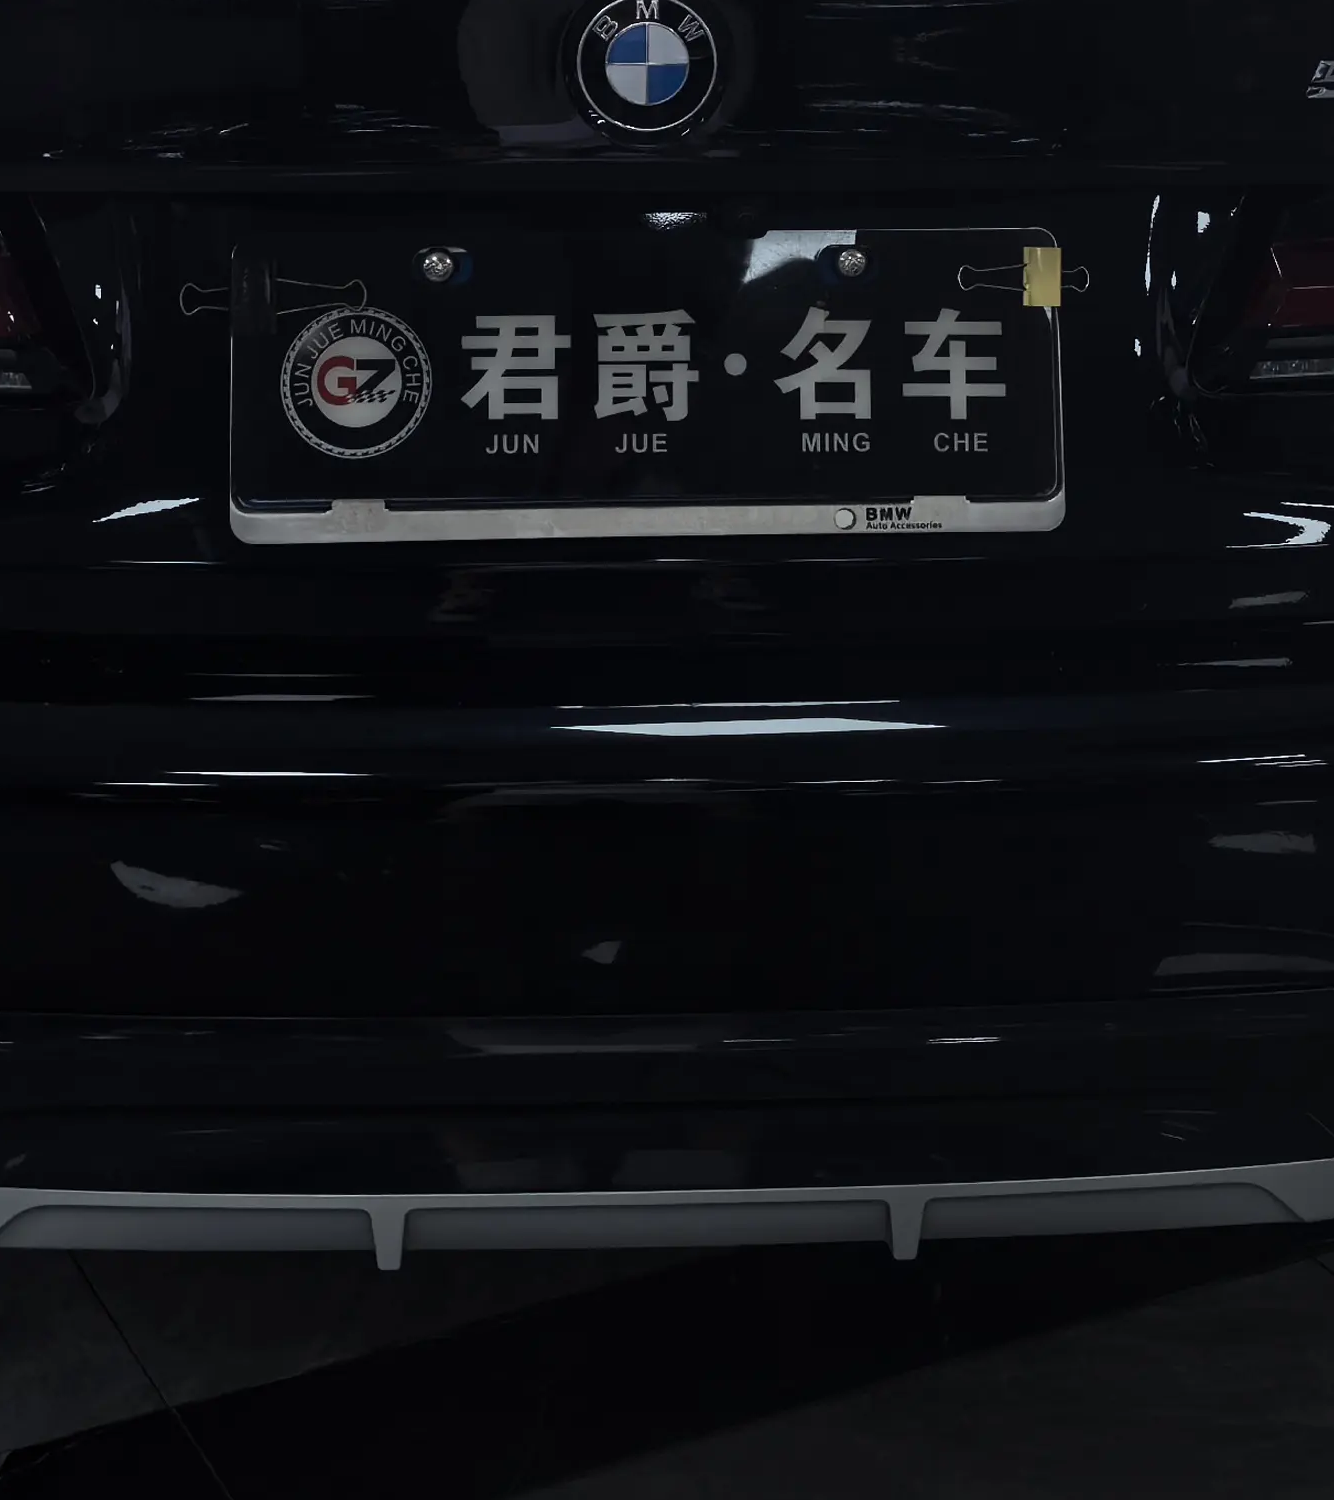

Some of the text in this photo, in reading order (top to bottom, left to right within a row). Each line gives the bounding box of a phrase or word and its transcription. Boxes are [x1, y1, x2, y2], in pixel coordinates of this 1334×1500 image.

[592, 0, 705, 41] BMW
[294, 318, 421, 407] JUN JUE MING CHE
[485, 432, 989, 454] JUN JUE MING CHE
[866, 507, 912, 521] BMW
[866, 521, 943, 530] Auto Accessories
